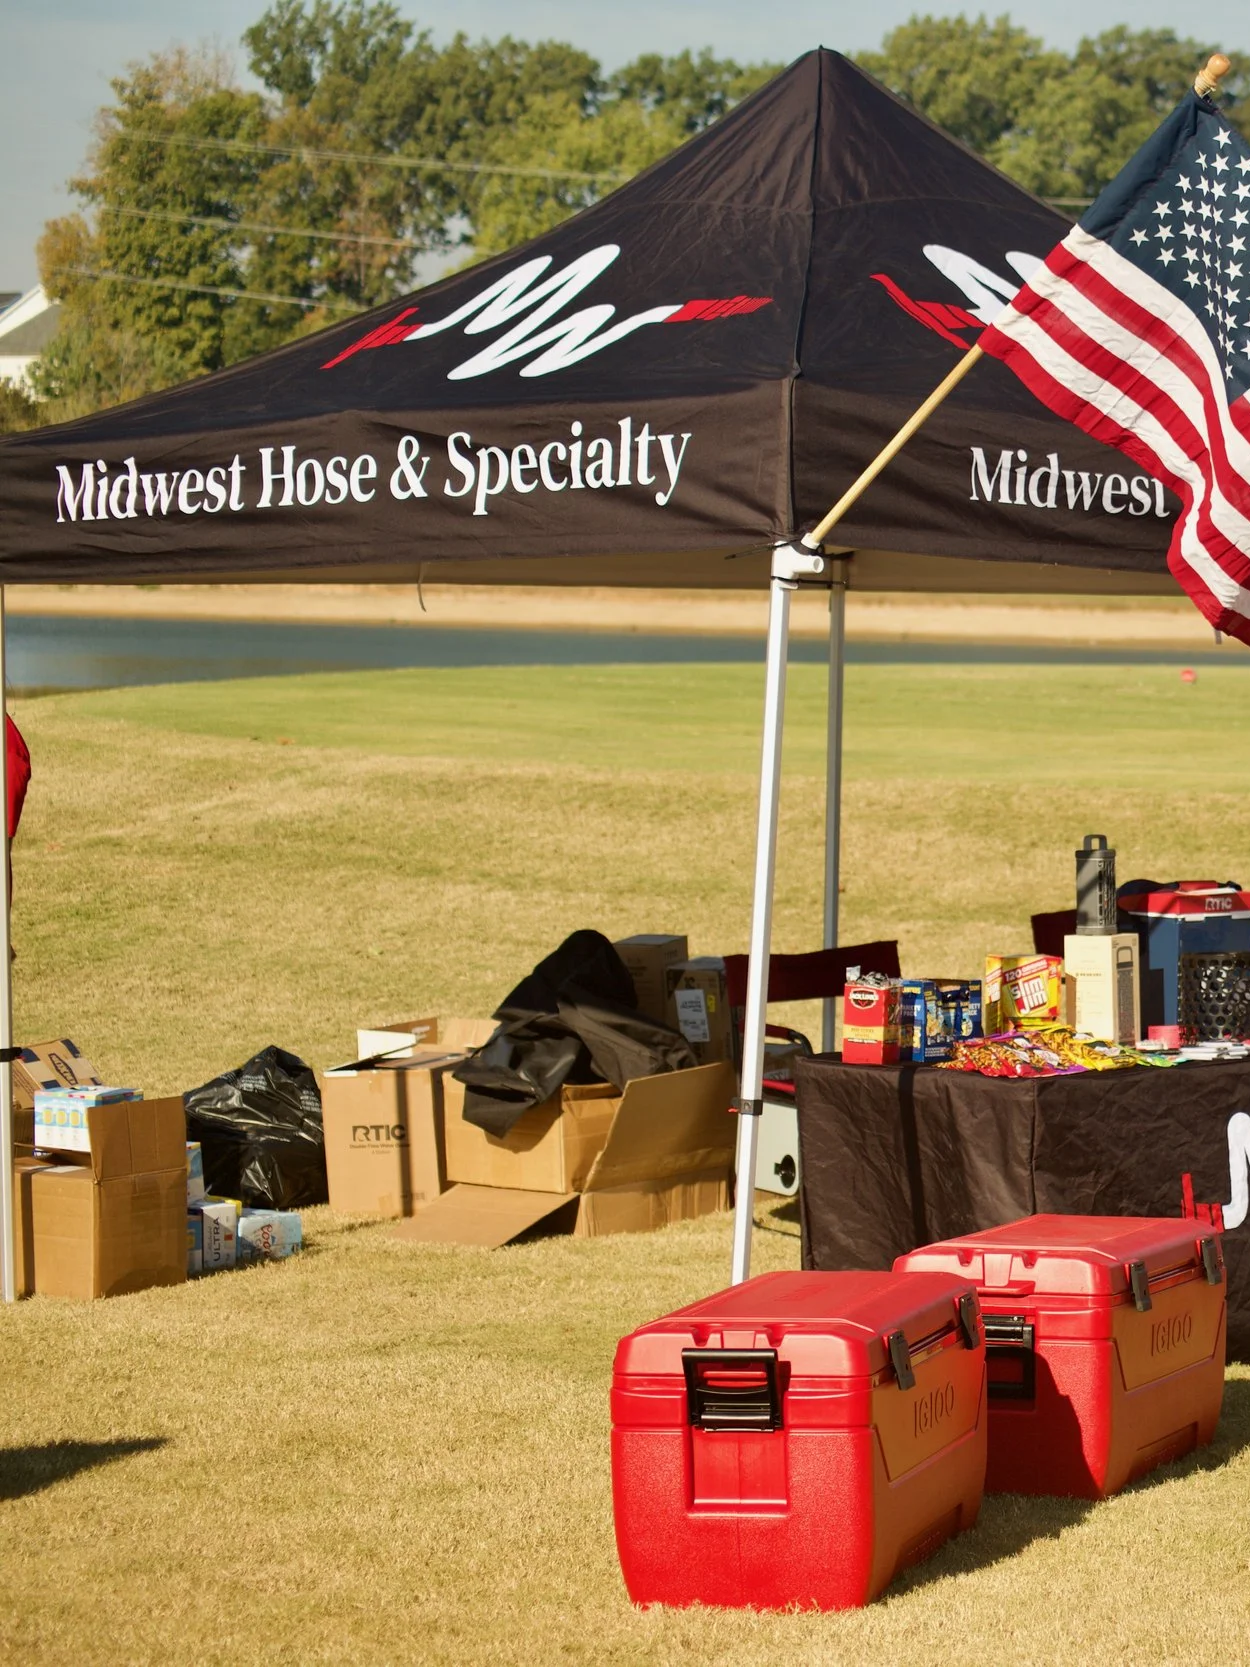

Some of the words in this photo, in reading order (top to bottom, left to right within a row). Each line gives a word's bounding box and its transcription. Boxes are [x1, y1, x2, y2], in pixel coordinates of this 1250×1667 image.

[56, 457, 246, 522] Midwest
[257, 445, 377, 508] Hose
[390, 434, 430, 499] &
[443, 416, 691, 516] Specialty
[969, 446, 1170, 518] Midwest
[1205, 897, 1232, 911] RTIC
[1005, 969, 1022, 982] 120
[352, 1124, 406, 1142] RTIC
[213, 1217, 221, 1262] ULTRA
